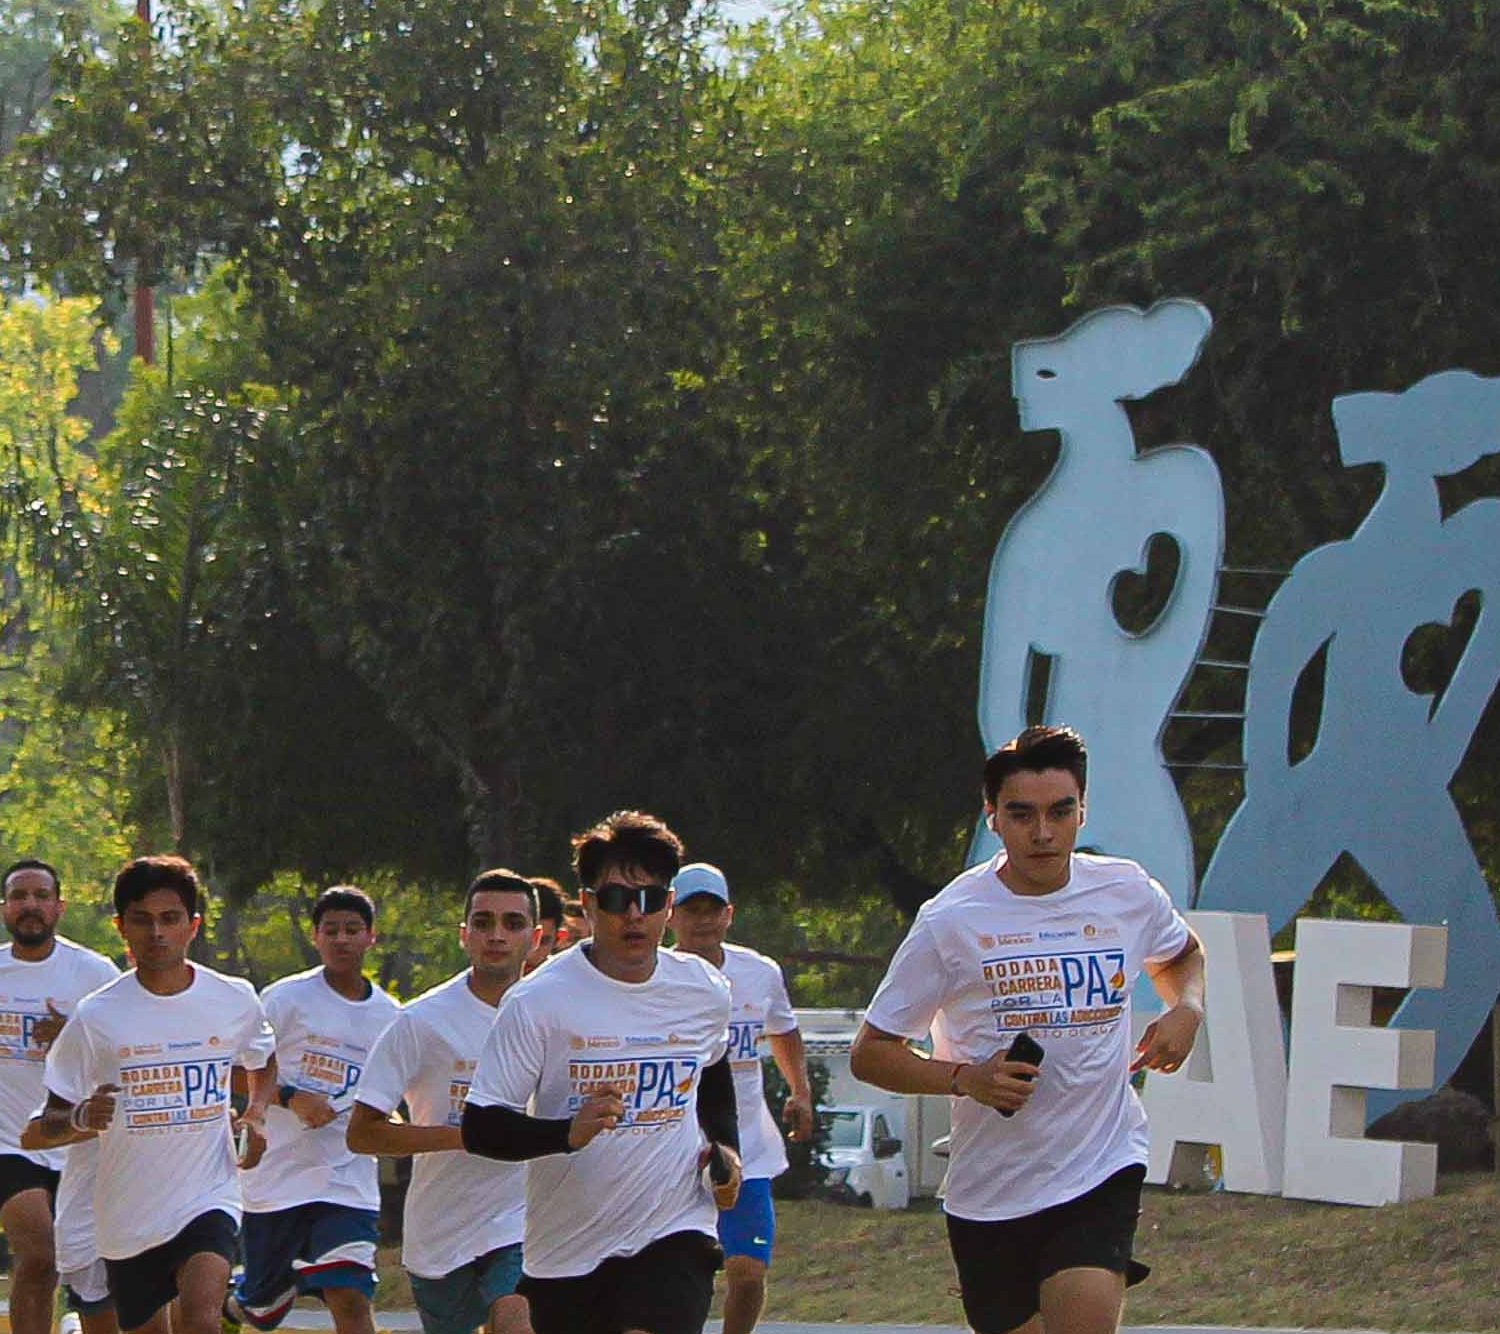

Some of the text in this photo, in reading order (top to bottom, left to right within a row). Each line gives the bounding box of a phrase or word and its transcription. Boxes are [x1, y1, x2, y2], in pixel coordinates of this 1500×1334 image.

[983, 958, 1059, 981] RODADA
[1060, 953, 1126, 1007] PAZ
[999, 975, 1063, 997] CARRERA
[991, 993, 1063, 1008] POR LA
[1049, 1011, 1069, 1025] LAS
[568, 1062, 637, 1080] RODADA
[635, 1061, 697, 1109] PAZ
